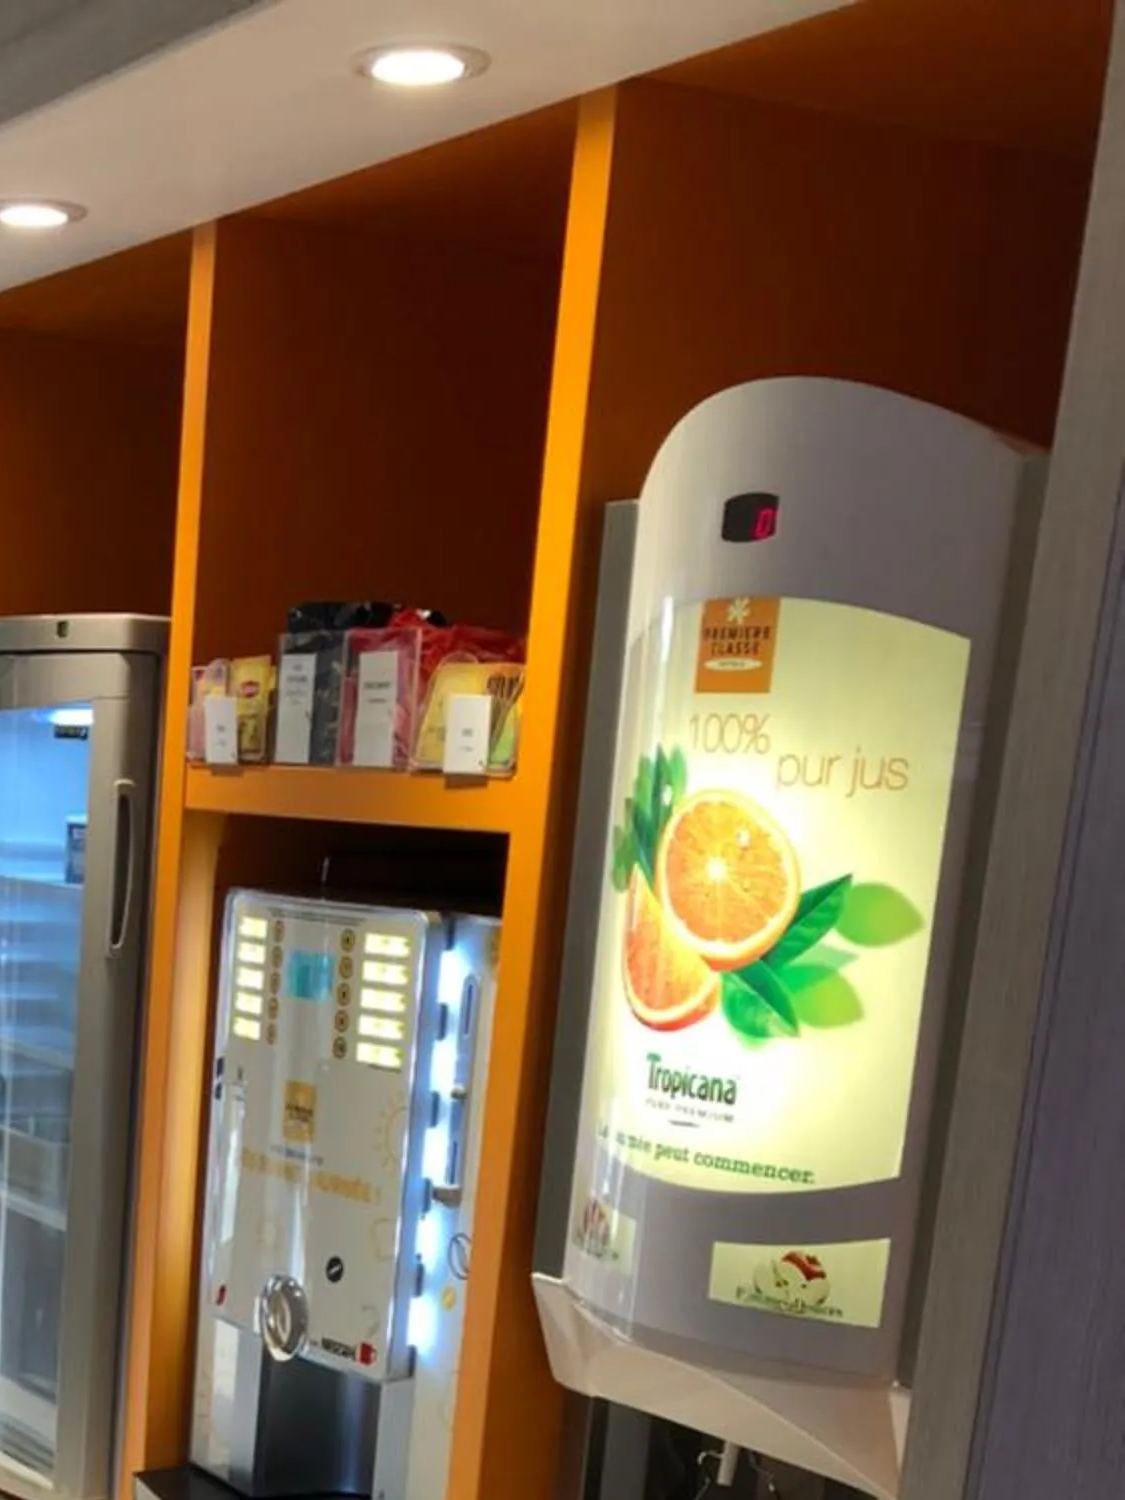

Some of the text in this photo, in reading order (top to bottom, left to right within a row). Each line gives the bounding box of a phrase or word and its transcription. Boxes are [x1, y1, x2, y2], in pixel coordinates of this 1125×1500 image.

[690, 712, 772, 754] 100%
[777, 745, 910, 798] pur jus
[646, 1052, 738, 1106] Tropicana
[654, 1141, 690, 1163] peut
[693, 1151, 816, 1185] commencer.
